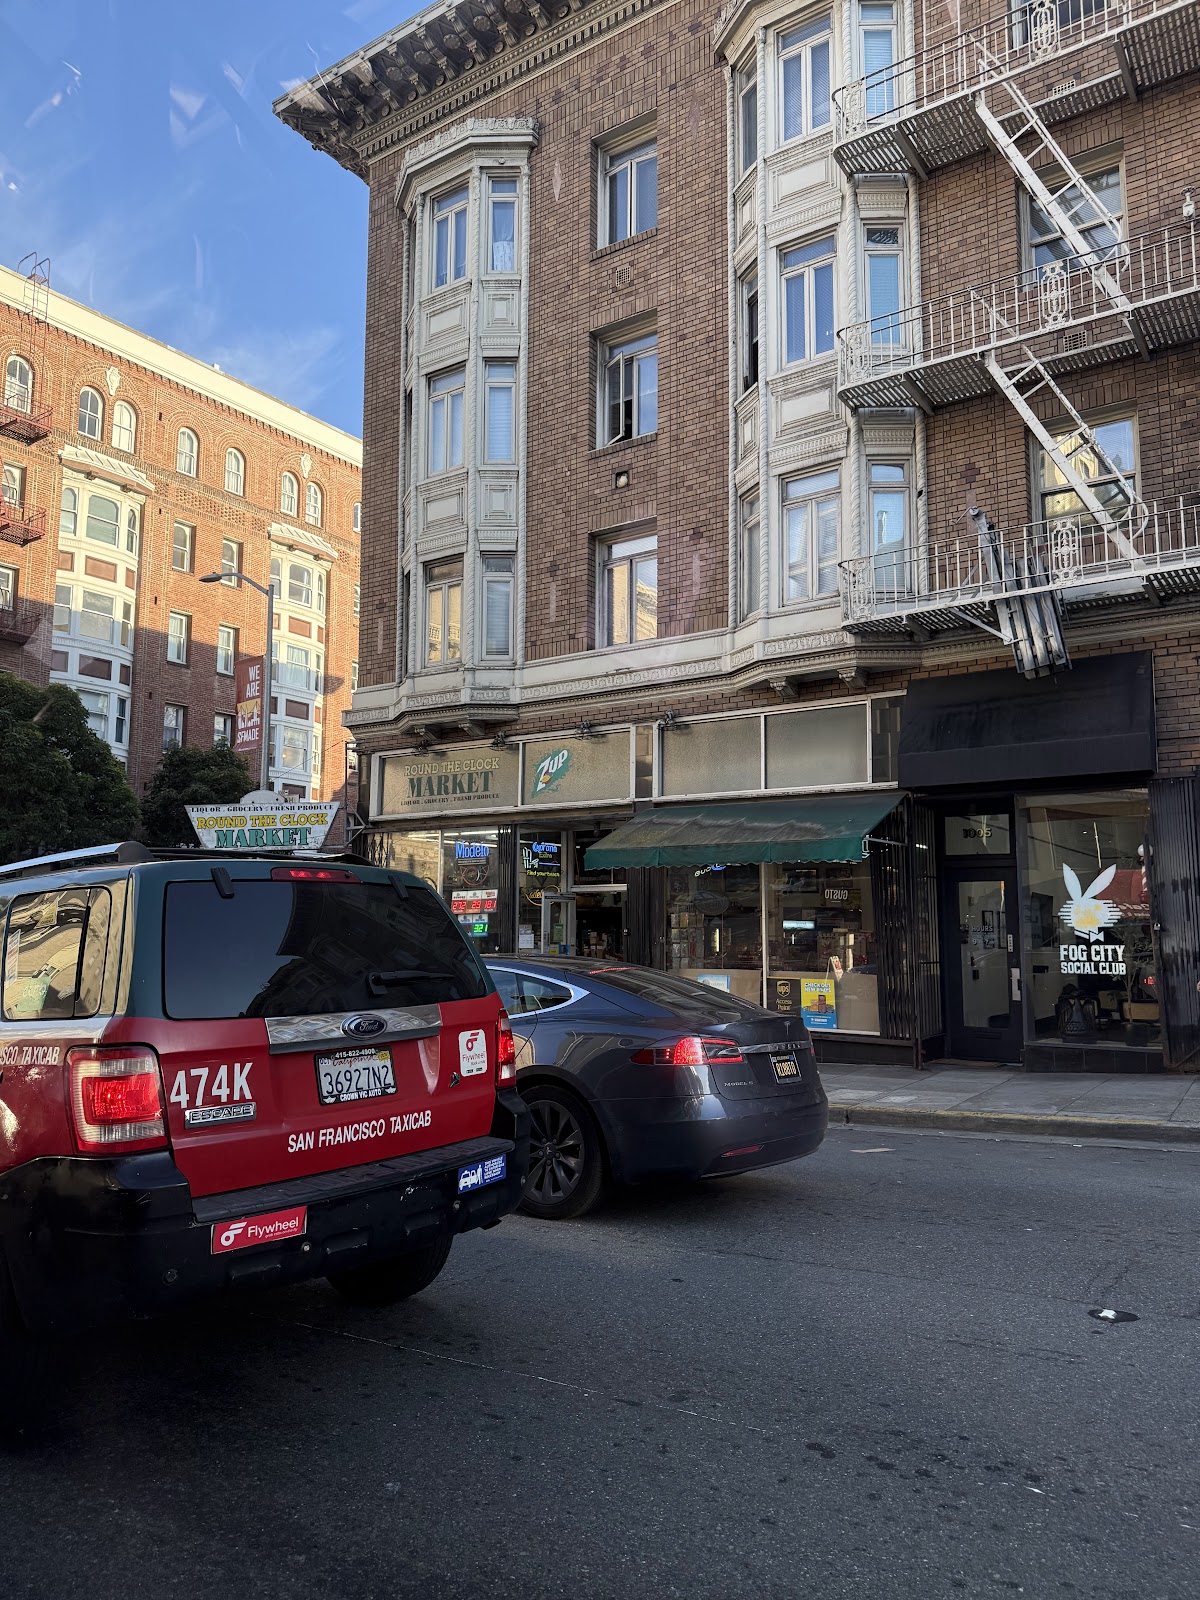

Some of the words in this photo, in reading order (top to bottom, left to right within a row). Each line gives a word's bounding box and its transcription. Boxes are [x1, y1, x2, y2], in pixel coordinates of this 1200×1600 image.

[248, 665, 260, 681] WE
[246, 681, 260, 698] ARE
[236, 728, 260, 744] SFMADE
[404, 763, 439, 776] ROUND
[441, 760, 461, 773] THE
[463, 757, 500, 770] CLOCK
[407, 770, 494, 798] MARKET
[227, 805, 263, 813] GROCERY
[297, 803, 334, 811] PRODUCE
[197, 816, 247, 829] ROUND
[250, 814, 277, 828] THE
[280, 813, 328, 827] CLOCK
[215, 827, 312, 849] MARKET
[455, 841, 489, 858] Modelo
[532, 842, 558, 853] Corona
[474, 923, 488, 932] 321
[1060, 945, 1088, 961] FOG
[1091, 945, 1125, 961] CITY
[1061, 962, 1098, 974] SOCIAL
[1099, 962, 1126, 975] CLUB
[359, 1021, 379, 1031] Ford
[0, 1046, 18, 1065] SCO
[21, 1046, 60, 1065] TAXICAB
[170, 1063, 253, 1109] 474K
[323, 1065, 391, 1095] 36927N2
[340, 1092, 359, 1101] CROWN
[359, 1091, 368, 1099] VIC
[369, 1089, 382, 1097] AUTO
[189, 1103, 254, 1123] ESCAPE
[288, 1131, 314, 1152] SAN
[319, 1119, 385, 1147] FRANCISCO
[390, 1110, 431, 1133] TAXICAB
[248, 1217, 299, 1238] Flywheel
